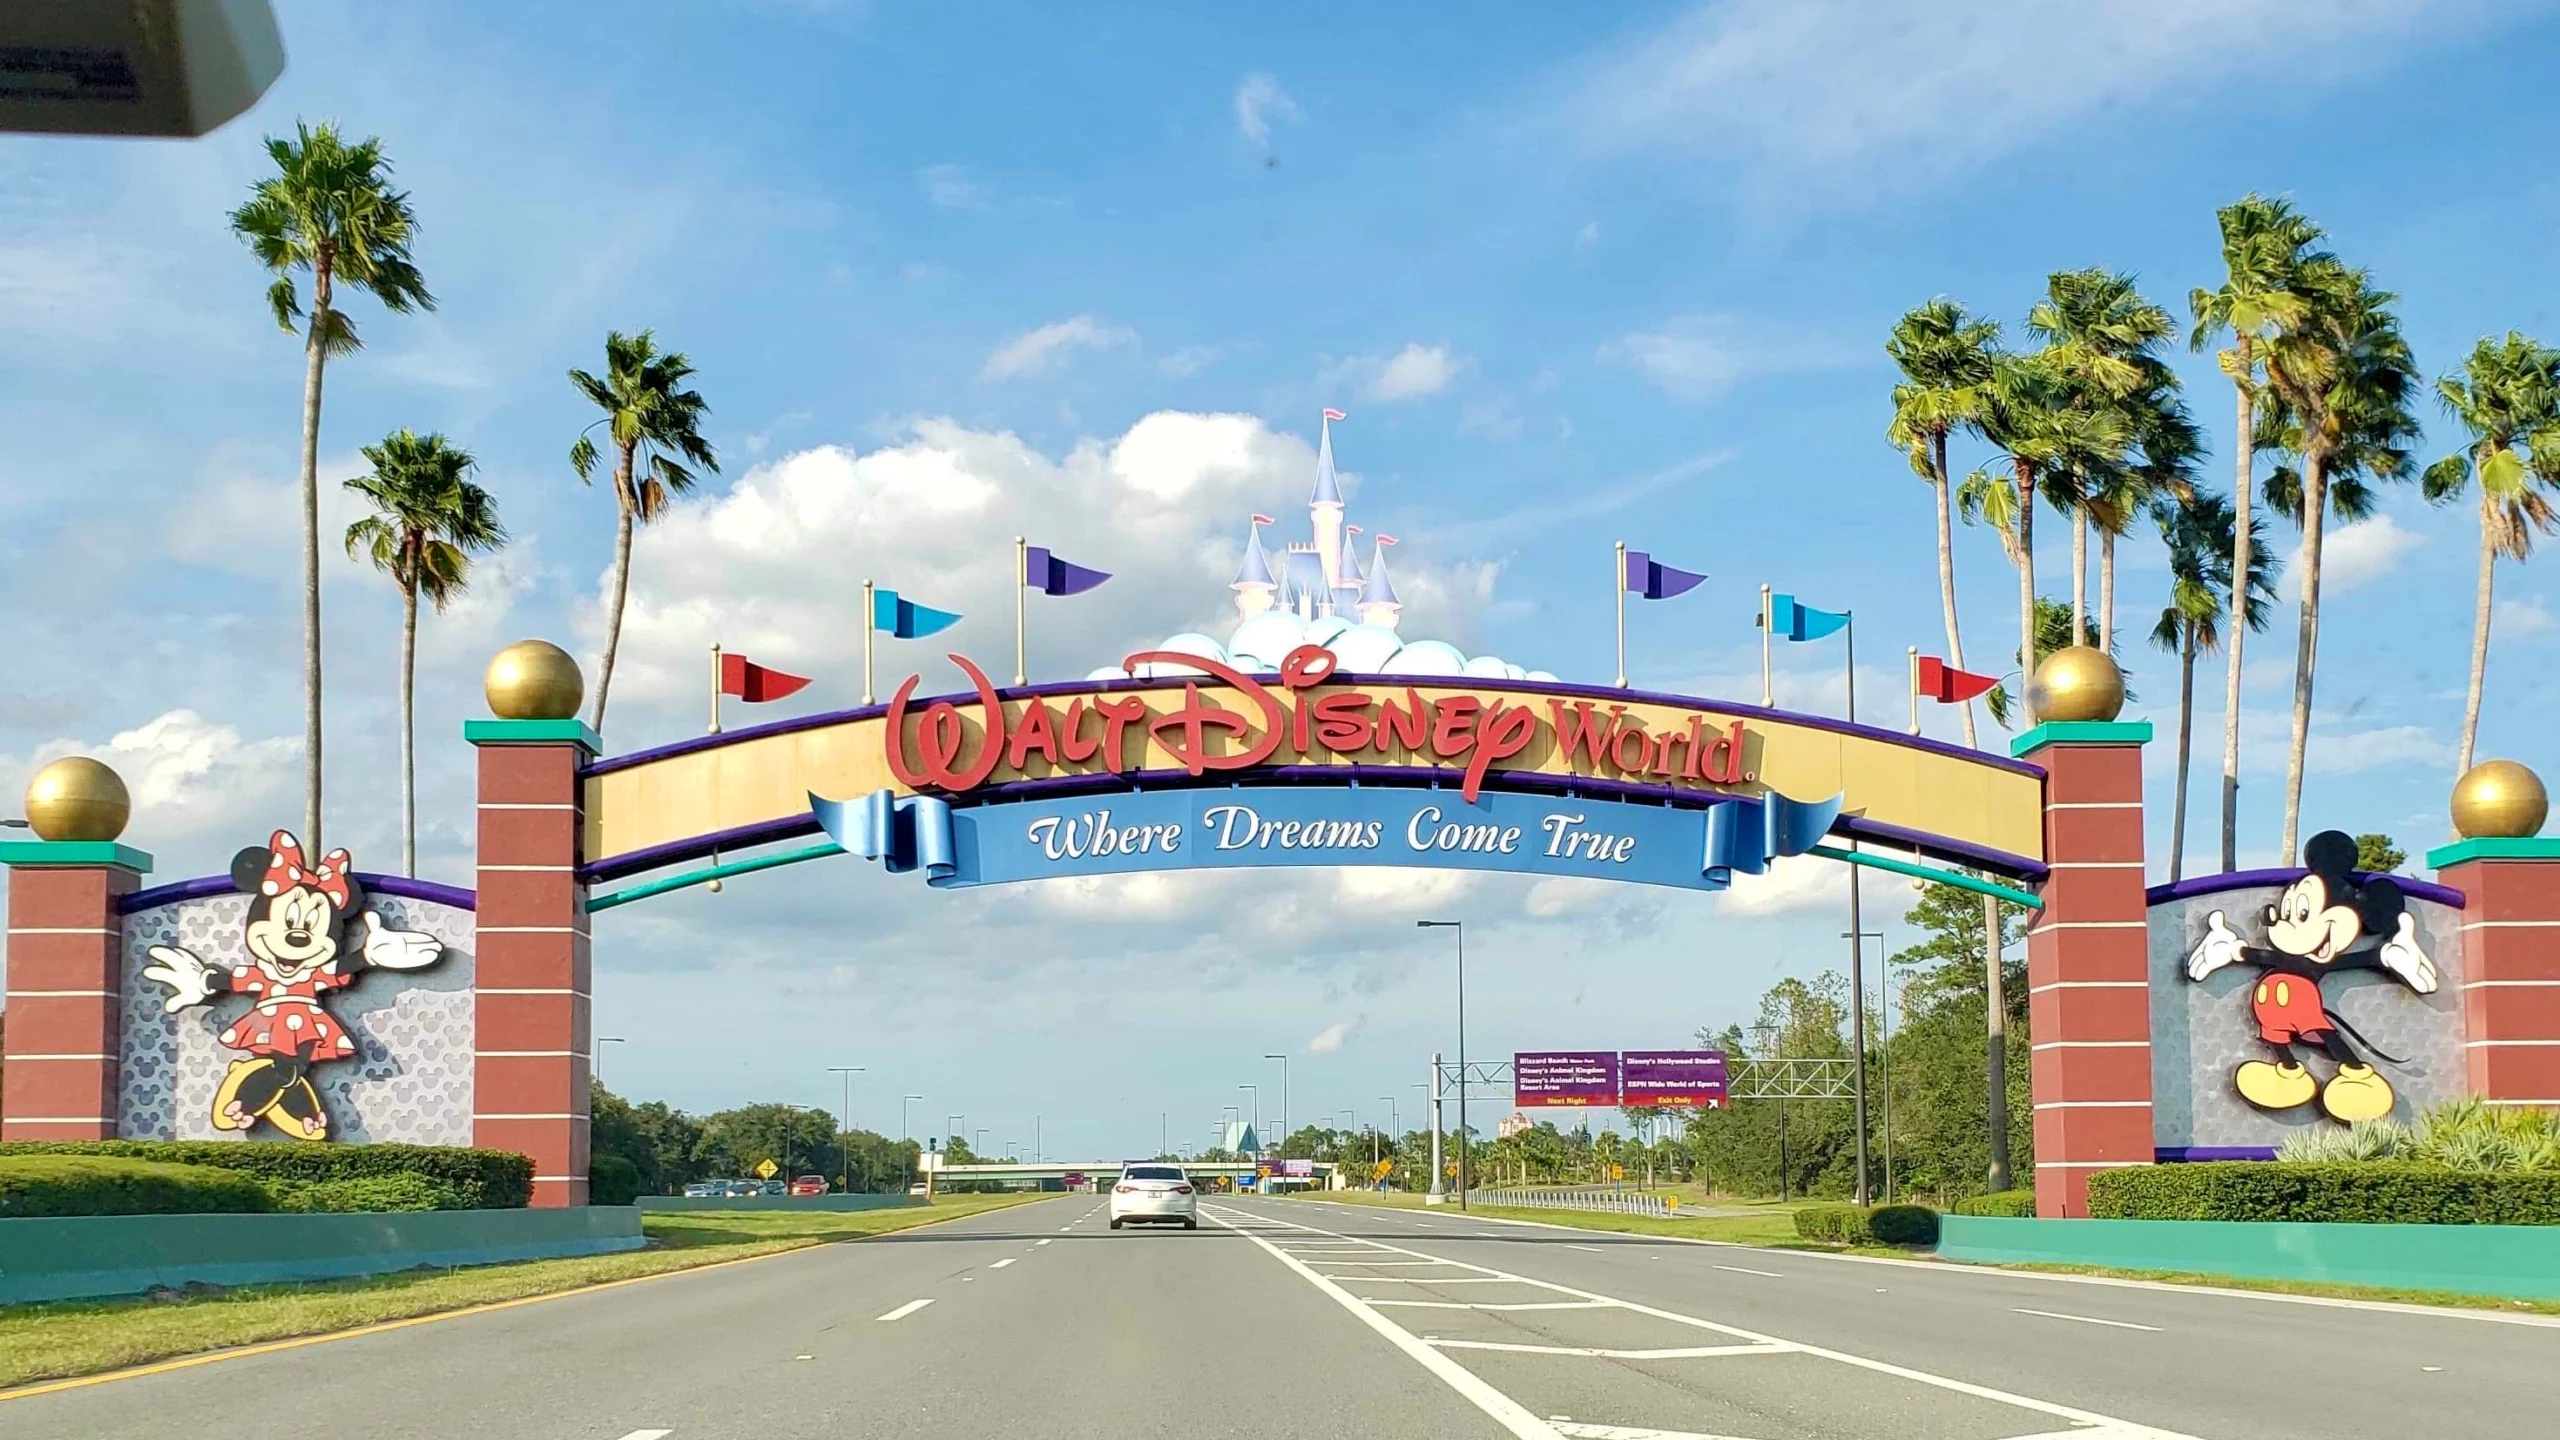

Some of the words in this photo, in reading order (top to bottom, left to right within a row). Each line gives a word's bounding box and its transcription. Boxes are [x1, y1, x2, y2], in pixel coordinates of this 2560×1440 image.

[1028, 811, 1181, 861] Where
[1203, 806, 1384, 851] Dreams
[1406, 806, 1523, 854] Come
[1541, 811, 1637, 865] True
[1626, 1057, 1656, 1066] Disney's
[1657, 1057, 1693, 1066] Hollywood
[1694, 1057, 1721, 1065] Studios
[1519, 1067, 1549, 1075] Disney's
[1575, 1066, 1606, 1075] Kingdom
[1519, 1077, 1549, 1085] Disney's
[1575, 1077, 1606, 1085] Kingdom
[1627, 1080, 1647, 1088] ESPN
[1648, 1080, 1666, 1088] Wide
[1666, 1080, 1687, 1088] World
[1688, 1080, 1696, 1088] of
[1697, 1080, 1720, 1088] Sports
[1547, 1097, 1565, 1105] Next
[1566, 1097, 1587, 1106] Right
[1657, 1096, 1673, 1104] Exit
[1673, 1096, 1692, 1105] Only
